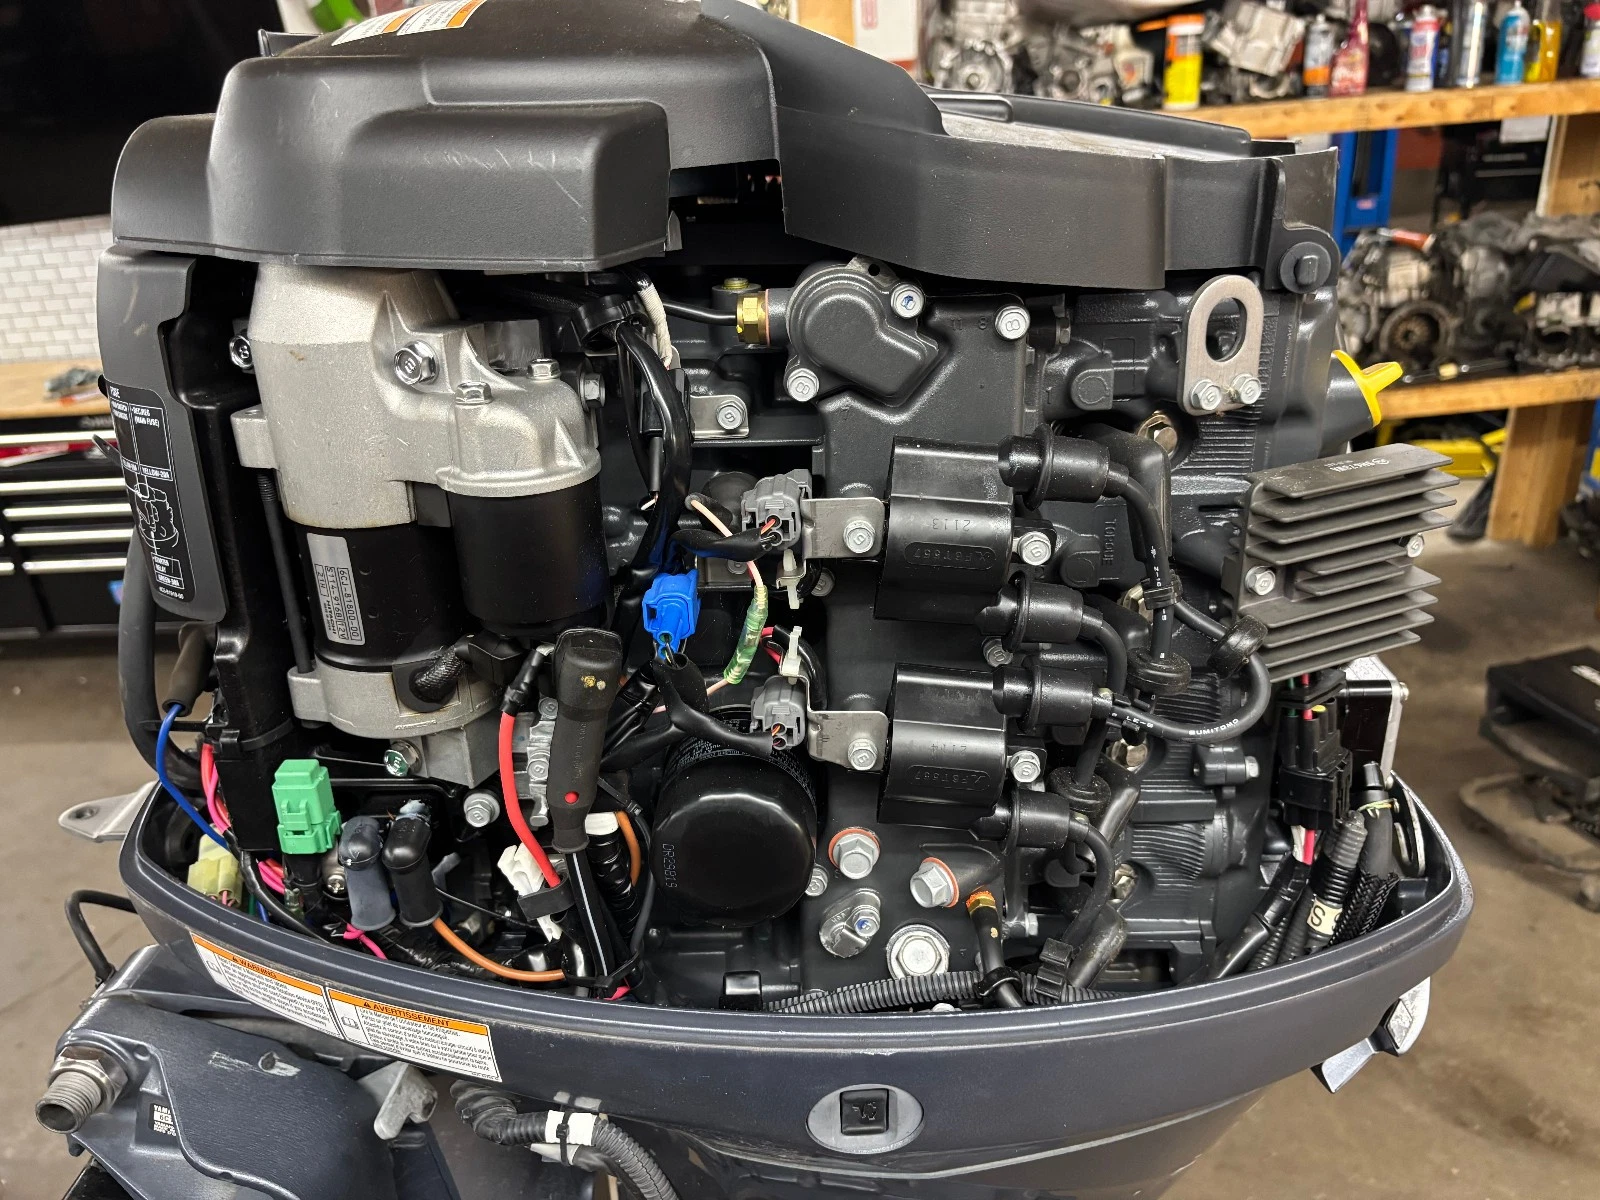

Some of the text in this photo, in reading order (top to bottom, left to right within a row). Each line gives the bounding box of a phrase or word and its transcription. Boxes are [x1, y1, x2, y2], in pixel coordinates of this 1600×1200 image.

[932, 518, 971, 532] 2113
[1102, 519, 1117, 565] TORQUE
[339, 570, 360, 638] 6CJ-81800-00
[326, 600, 337, 635] HITACHI
[1188, 718, 1240, 736] SUMITOMO
[1310, 905, 1326, 927] S
[238, 958, 277, 979] WARNING
[373, 1002, 451, 1027] AVERTISSEMENT
